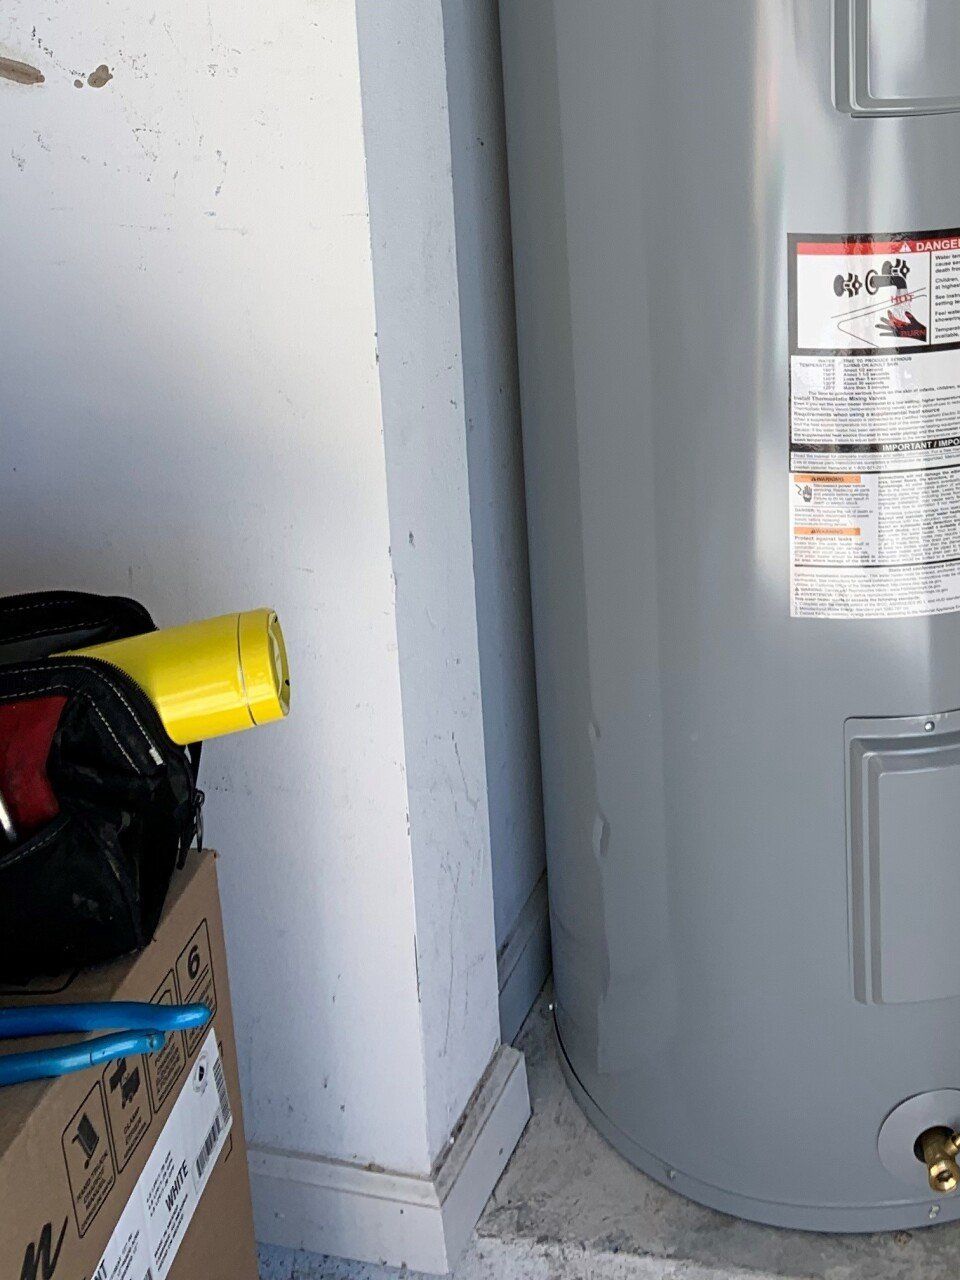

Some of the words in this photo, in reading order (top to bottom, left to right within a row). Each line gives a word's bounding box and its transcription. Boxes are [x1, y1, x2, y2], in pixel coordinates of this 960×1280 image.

[882, 441, 932, 452] IMPORTANT
[186, 944, 201, 980] 6
[165, 1159, 189, 1213] WHITE
